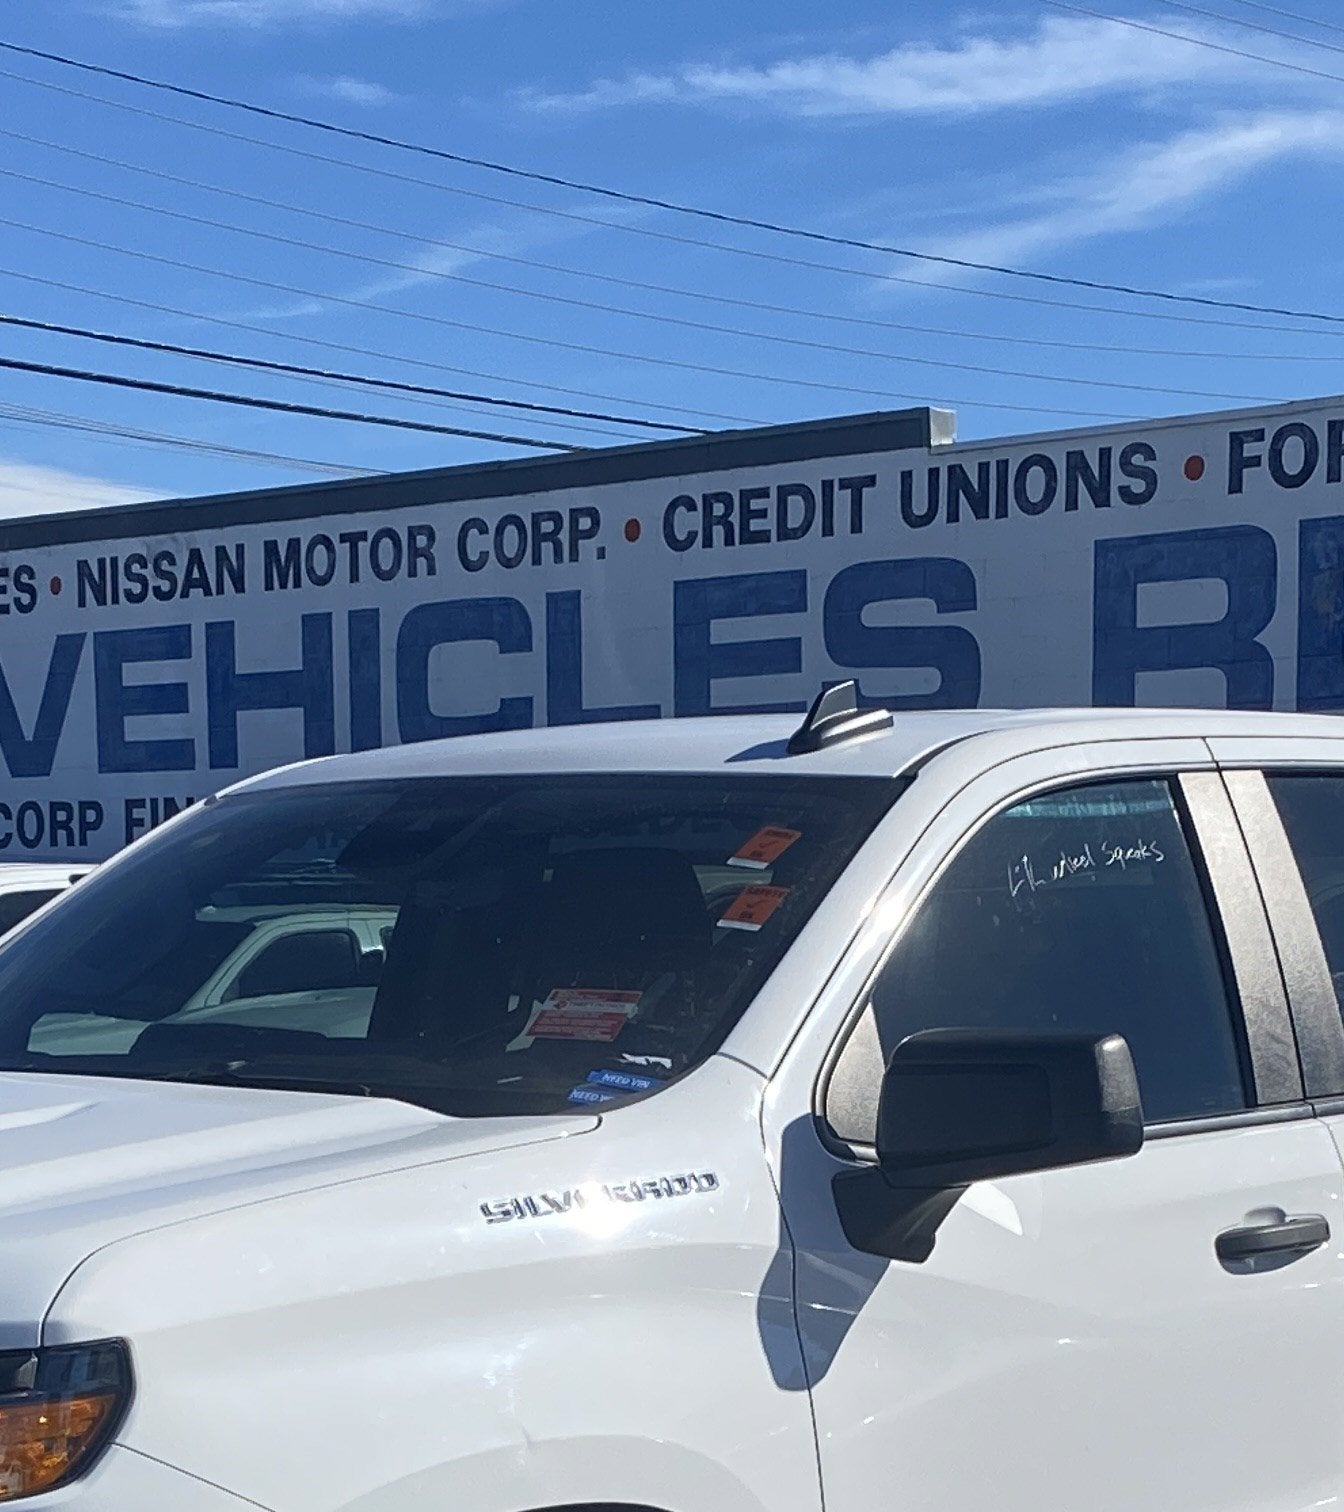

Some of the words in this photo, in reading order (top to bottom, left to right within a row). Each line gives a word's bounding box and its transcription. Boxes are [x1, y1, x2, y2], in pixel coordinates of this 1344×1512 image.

[77, 543, 246, 605] NISSAN
[263, 523, 436, 592] MOTOR
[457, 506, 607, 573] CORP.
[662, 475, 876, 553] CREDIT
[898, 442, 1158, 528] UNIONS
